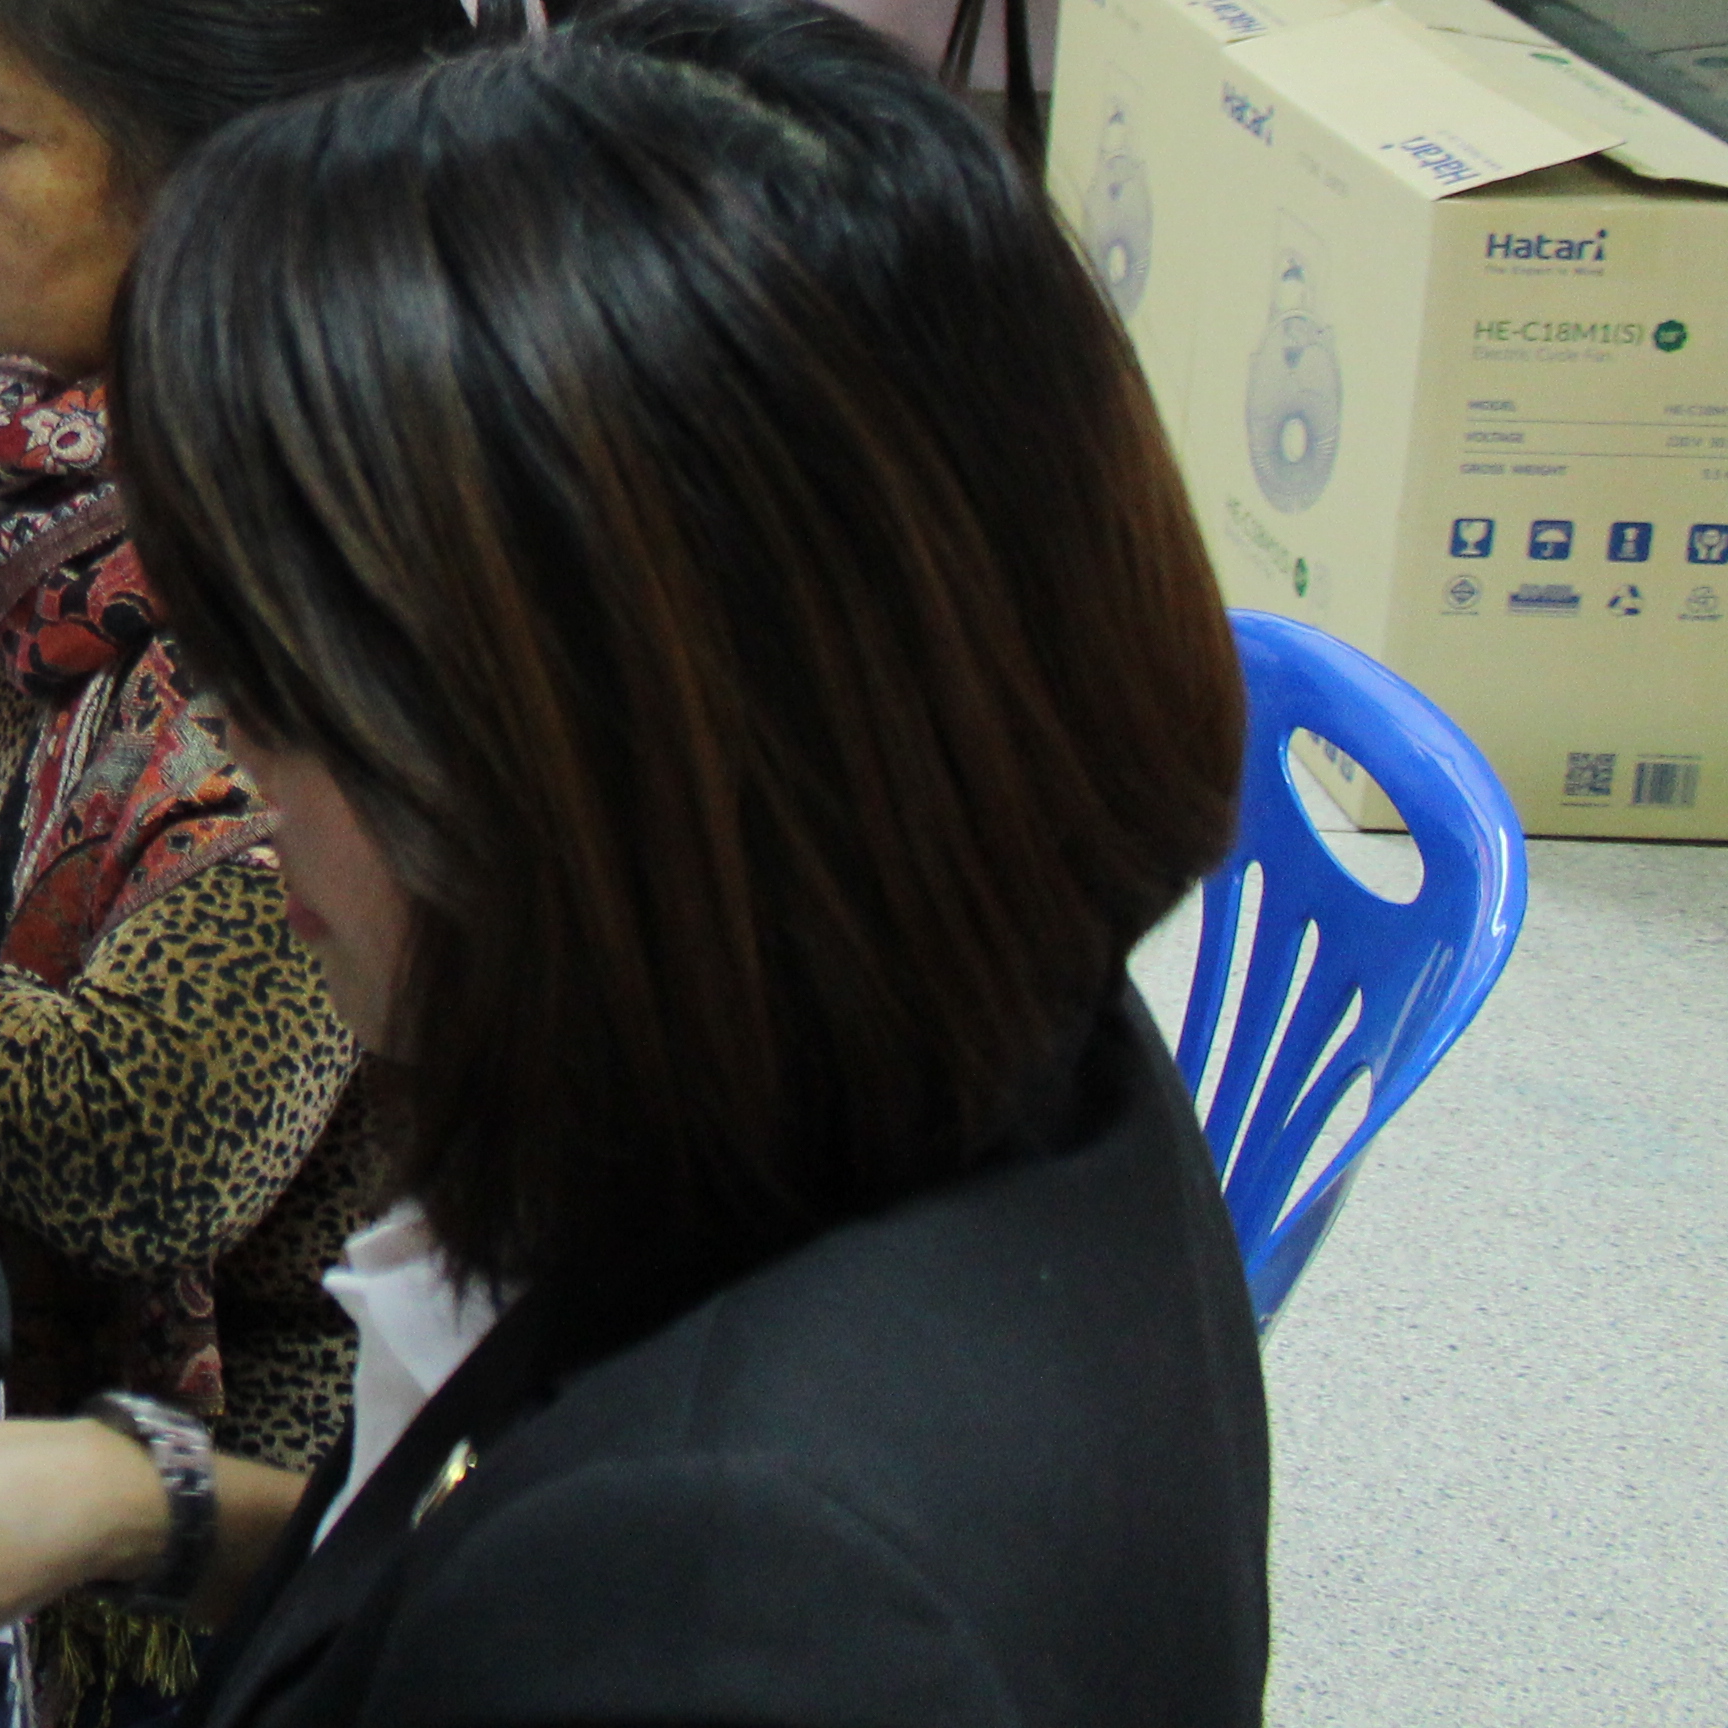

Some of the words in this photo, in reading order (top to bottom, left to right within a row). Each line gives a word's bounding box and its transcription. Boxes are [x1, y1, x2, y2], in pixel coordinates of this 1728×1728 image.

[1379, 134, 1484, 186] Hatari
[1485, 228, 1609, 262] Hatari
[1474, 320, 1644, 346] HE-C18M1(S)
